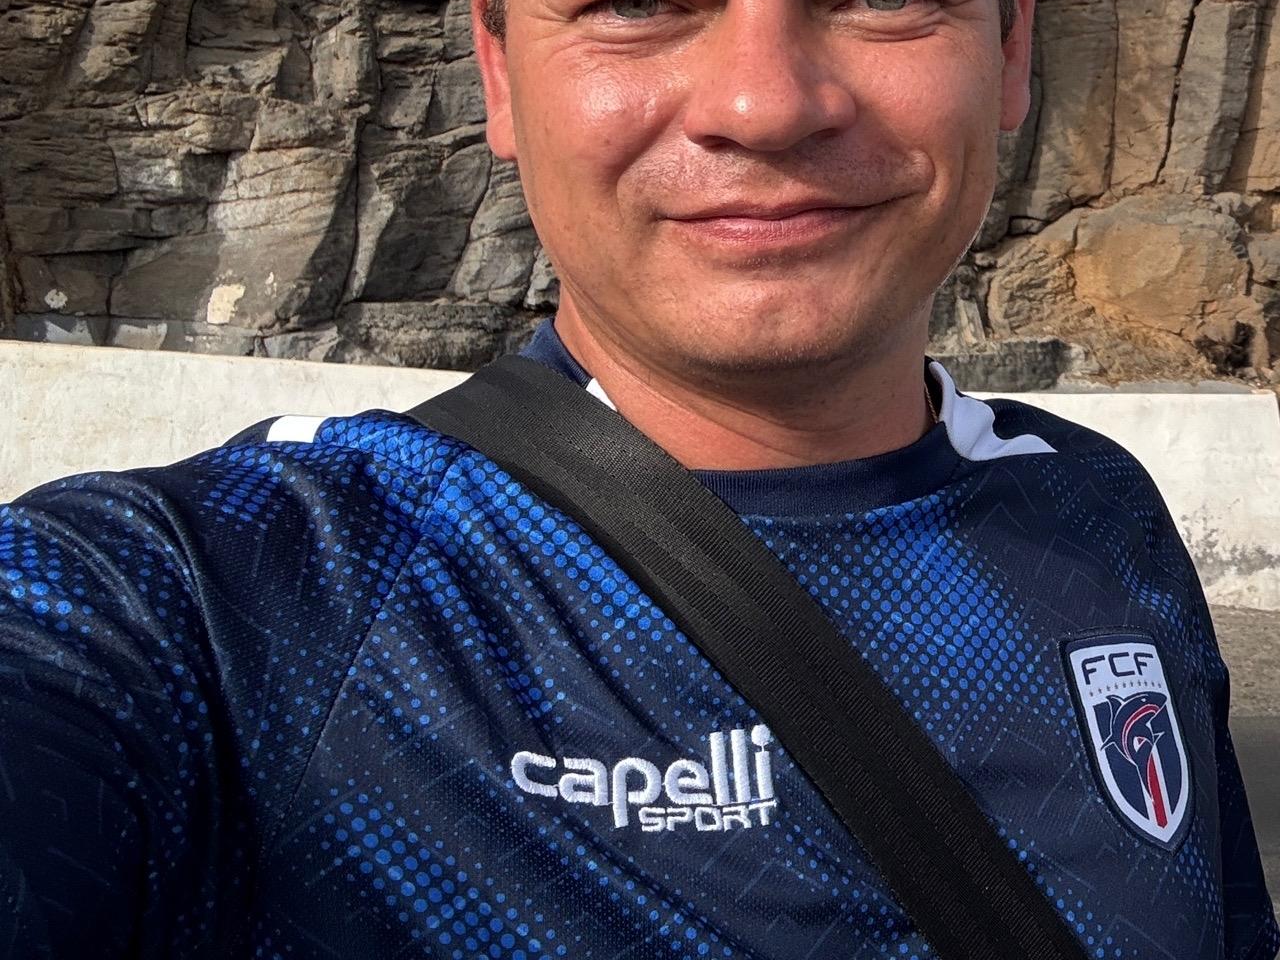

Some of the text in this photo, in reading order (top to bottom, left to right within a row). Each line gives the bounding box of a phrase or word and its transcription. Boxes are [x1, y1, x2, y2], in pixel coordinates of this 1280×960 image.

[1081, 651, 1154, 685] FCF
[511, 724, 775, 828] capelli
[638, 798, 777, 832] SPORT
